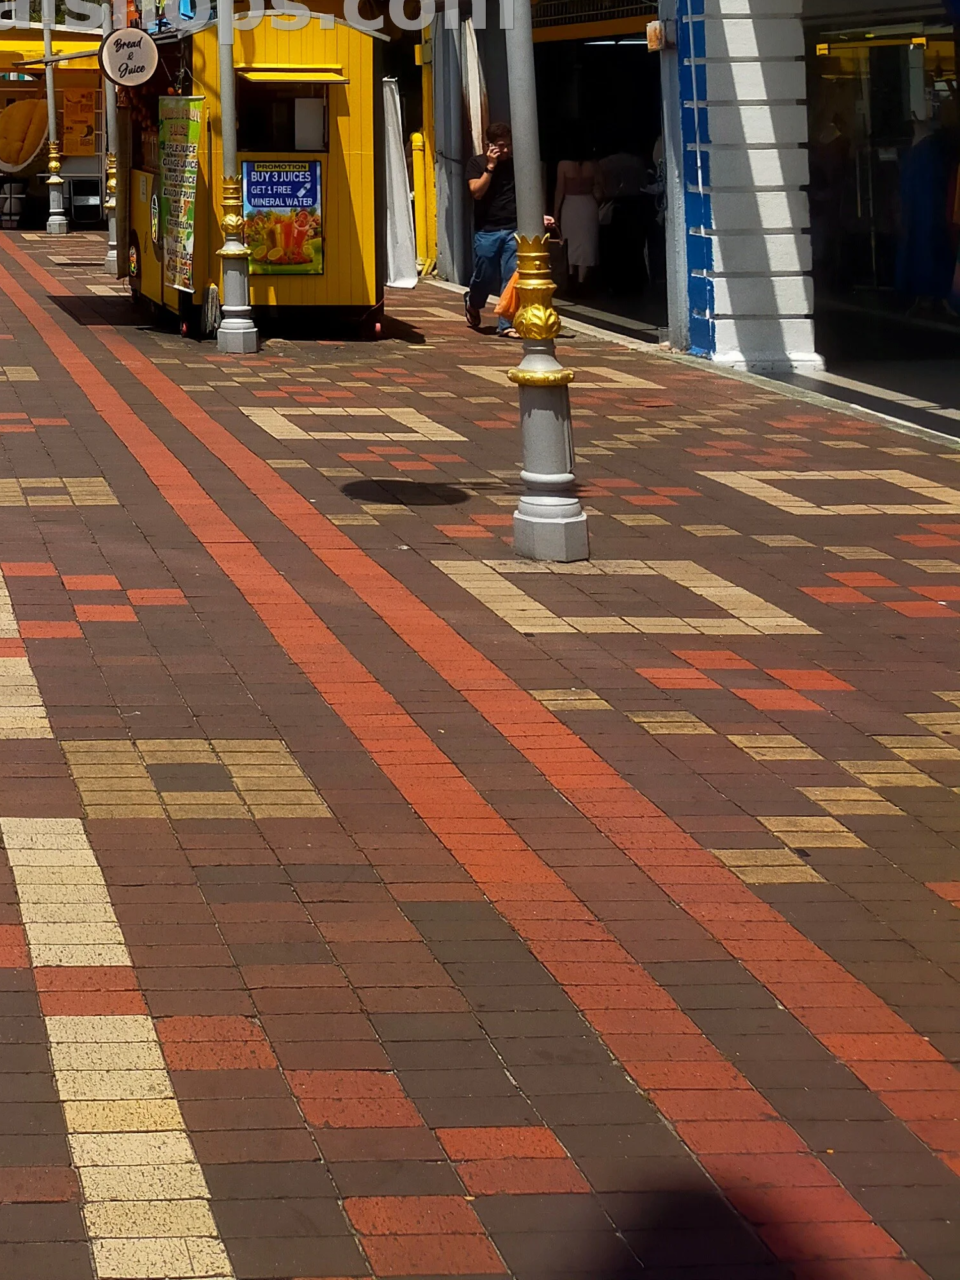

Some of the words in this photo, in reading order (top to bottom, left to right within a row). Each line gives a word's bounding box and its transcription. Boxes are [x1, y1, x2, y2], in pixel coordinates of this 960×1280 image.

[113, 36, 144, 53] Bread
[126, 51, 134, 61] &
[118, 62, 146, 79] Juice
[251, 171, 271, 182] BUY
[272, 171, 279, 182] 3
[279, 171, 311, 182] JUICES
[250, 185, 266, 194] GET
[267, 185, 272, 194] 1
[273, 185, 292, 194] FREE
[251, 197, 285, 207] MINERAL
[285, 197, 313, 206] WATER
